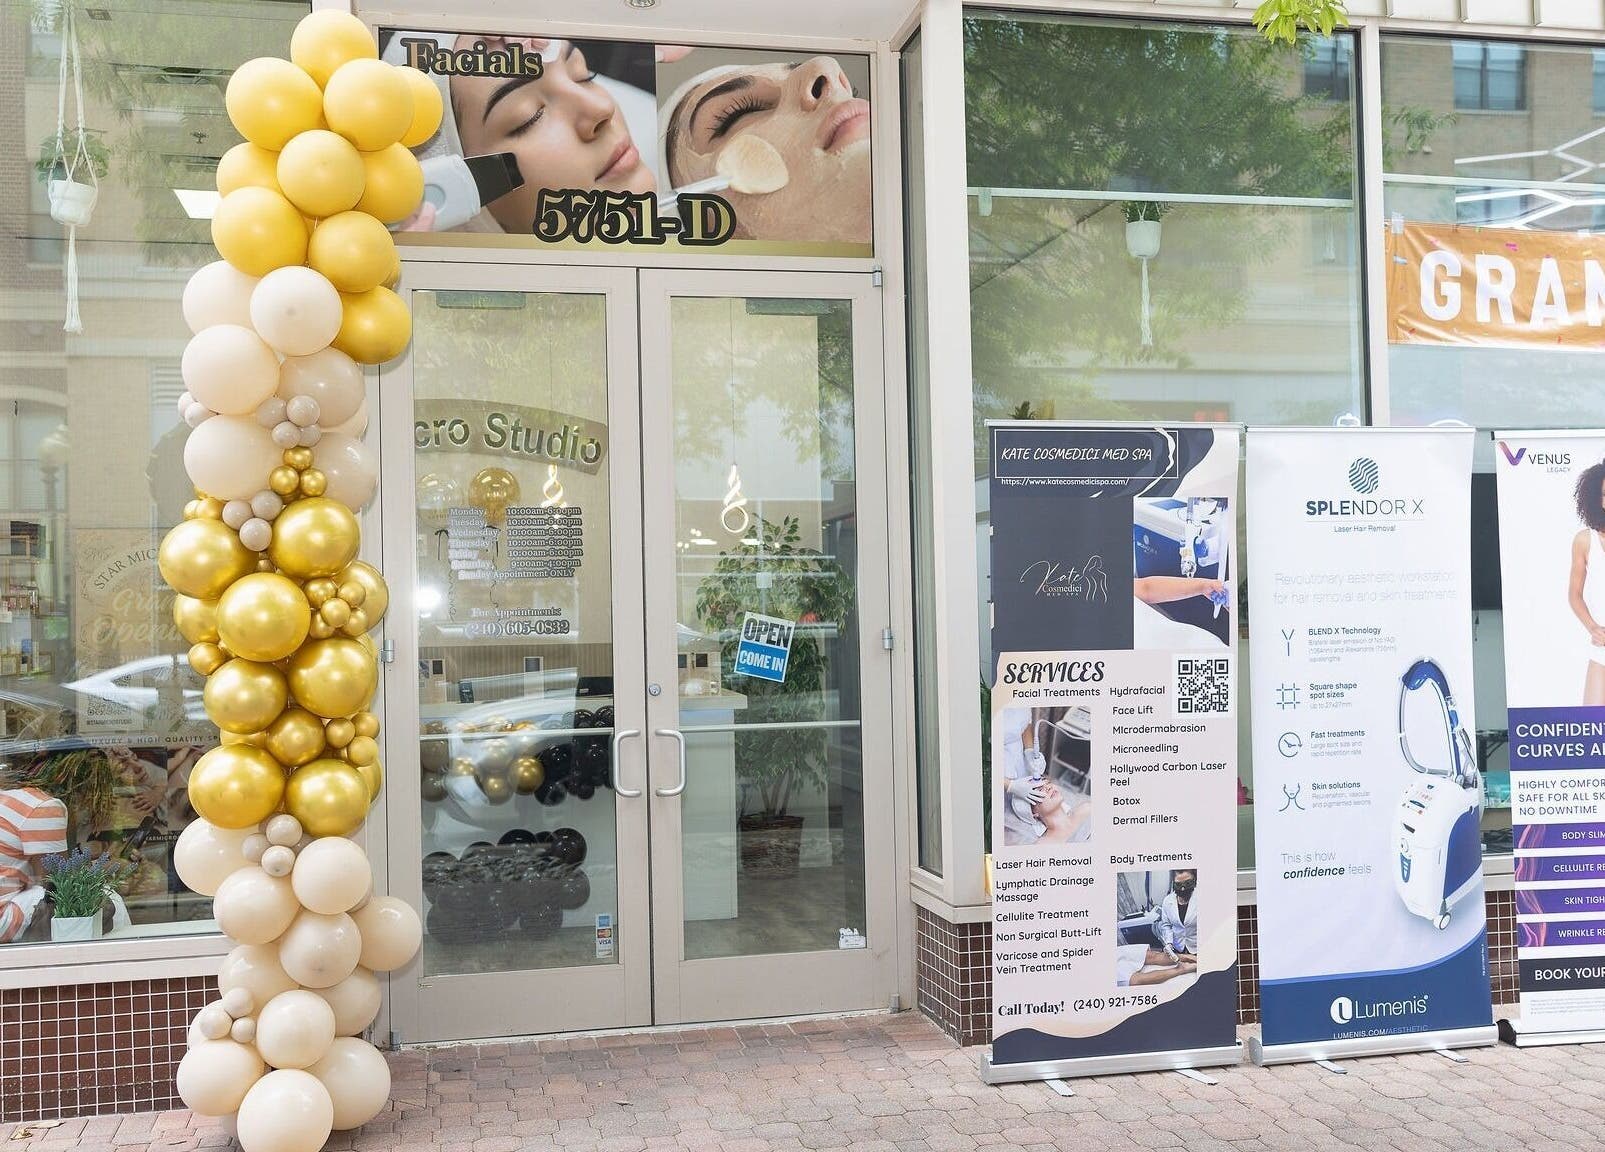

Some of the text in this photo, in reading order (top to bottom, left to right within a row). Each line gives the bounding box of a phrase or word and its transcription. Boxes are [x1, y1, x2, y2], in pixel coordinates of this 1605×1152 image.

[402, 39, 543, 78] Facials
[535, 191, 735, 245] 5751-D
[483, 412, 601, 464] Studio
[1001, 447, 1152, 461] KATE COSMEDICI MED SPA
[1528, 454, 1571, 465] VENUS
[1001, 478, 1129, 486] https://www.katecosmedicispa.com/
[507, 507, 582, 515] 10:00am-6:00pm
[1306, 499, 1424, 516] SPLENDOR X
[508, 528, 583, 536] 10:00am-6:00pm
[1334, 525, 1352, 533] Laser
[1368, 524, 1396, 532] Removal
[508, 538, 583, 547] 10:00am-6:00pm
[94, 560, 126, 590] STAR
[127, 548, 160, 565] MIC
[511, 560, 581, 568] 9:00am-4:00pm
[494, 570, 548, 578] Appointment
[550, 568, 575, 577] ONLY
[1020, 560, 1084, 595] Kate
[1042, 584, 1082, 593] Cosmedici
[465, 620, 570, 636] (240) 605-0832
[743, 617, 792, 648] OPEN
[1308, 626, 1381, 636] BLEND X Technology
[739, 650, 784, 672] COME IN
[1003, 661, 1105, 684] SERVICES
[1109, 686, 1166, 697] Hydrafacial
[1309, 682, 1357, 691] Square shape
[1012, 688, 1101, 698] Facial Treatments
[1309, 690, 1345, 699] spot sizes
[1112, 705, 1154, 715] Face Lift
[165, 735, 202, 743] QUALITY
[1310, 730, 1366, 739] Fast treatments
[1112, 743, 1179, 754] Microneedling
[1517, 742, 1584, 758] CURVES
[1110, 761, 1227, 774] Hollywood Carbon Laser
[1110, 777, 1130, 786] Peel
[1311, 781, 1361, 790] Skin solutions
[1518, 780, 1557, 789] HIGHLY
[1112, 796, 1141, 806] Botox
[1519, 793, 1545, 802] SAFE
[1548, 793, 1569, 802] FOR
[1572, 792, 1590, 801] ALL
[1519, 805, 1598, 816] NO DOWNTIME
[1112, 814, 1178, 825] Dermal Fillers
[1562, 831, 1586, 840] BODY
[1110, 852, 1192, 866] Body Treatments
[1281, 850, 1336, 864] This is how
[996, 856, 1092, 870] Laser Hair Removal
[1553, 863, 1594, 873] CELLULITE
[1283, 863, 1372, 880] confidence feels
[996, 876, 1094, 890] Lymphatic Drainage
[996, 893, 1039, 903] Massage
[1564, 896, 1583, 905] SKIN
[996, 909, 1089, 922] Cellulite Treatment
[996, 927, 1102, 942] Non Surgical Butt-Lift
[1558, 929, 1594, 938] WRINKLE
[996, 947, 1094, 962] Varicose and Spider
[996, 962, 1072, 975] Vein Treatment
[1534, 968, 1572, 981] BOOK
[998, 995, 1158, 1017] Call Today! (240) 921-7586
[1355, 994, 1427, 1019] Lumenis
